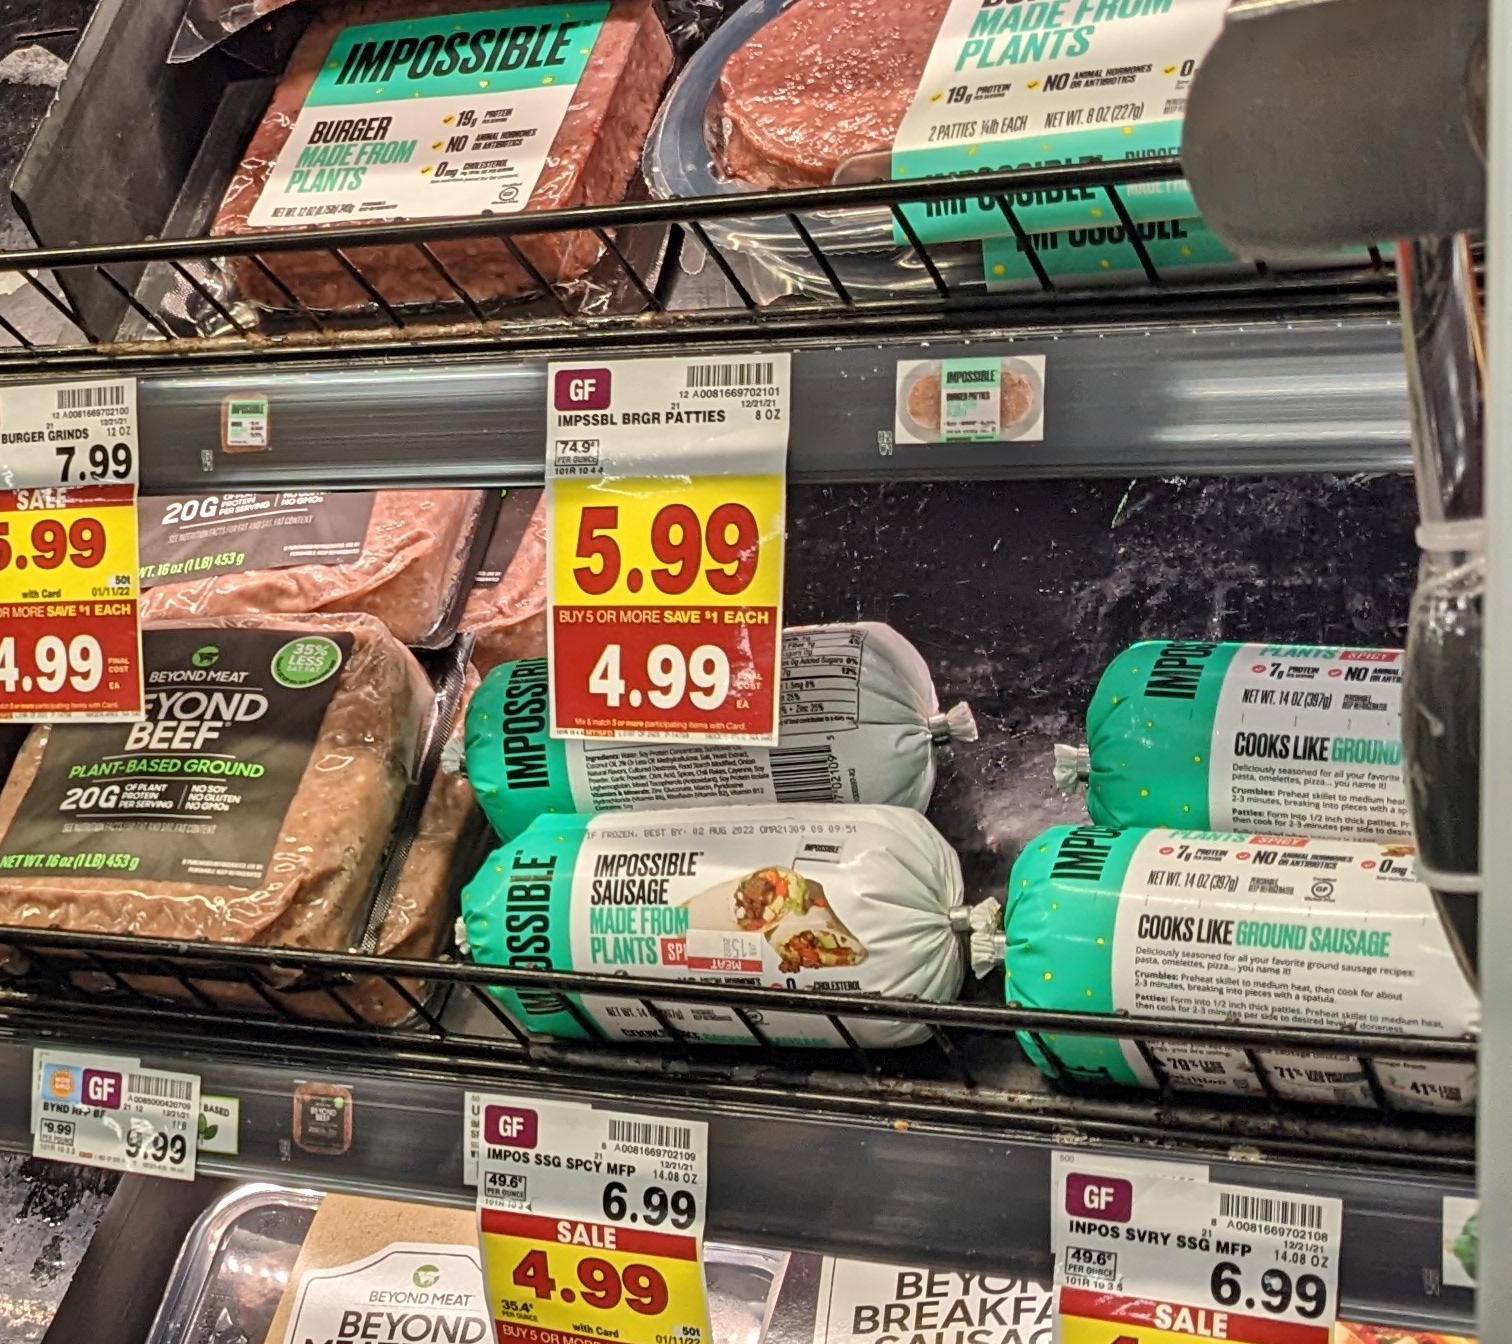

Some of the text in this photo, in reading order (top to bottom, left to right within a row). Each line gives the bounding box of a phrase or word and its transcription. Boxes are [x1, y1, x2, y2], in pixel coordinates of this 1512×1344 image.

[969, 0, 1065, 38] MADE
[336, 23, 572, 85] IMPOSSIBLE
[954, 26, 1095, 71] PLANTS
[308, 117, 392, 145] BURGER
[285, 167, 365, 194] PLANTS
[569, 379, 596, 401] GF
[693, 387, 780, 399] A0081669702101
[558, 410, 725, 427] IMPSSBL BRGR PATTIES
[1, 431, 46, 444] BURGER
[48, 429, 89, 441] GRINDS
[56, 443, 133, 482] 7.99
[16, 489, 67, 510] SALE
[573, 503, 760, 595] 5.99
[22, 589, 61, 599] with Card
[12, 604, 131, 617] MORE SAVE EACH
[589, 643, 730, 711] 4.99
[125, 723, 221, 751] BEEF
[68, 759, 264, 779] PLANT-BASED GROUND
[593, 853, 697, 878] IMPOSSIBLE
[591, 879, 669, 906] SAUSAGE
[590, 906, 688, 935] MADE FROM
[1138, 914, 1390, 957] COOKS LIKE GROUND SAUSAGE
[591, 938, 656, 965] PLANTS
[1135, 971, 1178, 982] Crumbles:
[203, 1104, 230, 1117] BASED
[498, 1117, 524, 1138] GF
[487, 1148, 636, 1176] IMPOS SSG SPCY MFP
[603, 1181, 696, 1229] 6.99
[557, 1222, 616, 1250] SALE
[1069, 1220, 1252, 1257] INPOS SVRY SSG MFP
[512, 1250, 668, 1315] 4.99
[1211, 1261, 1327, 1319] 6.99
[338, 1311, 486, 1344] BEYOND
[1154, 1304, 1227, 1337] SALE
